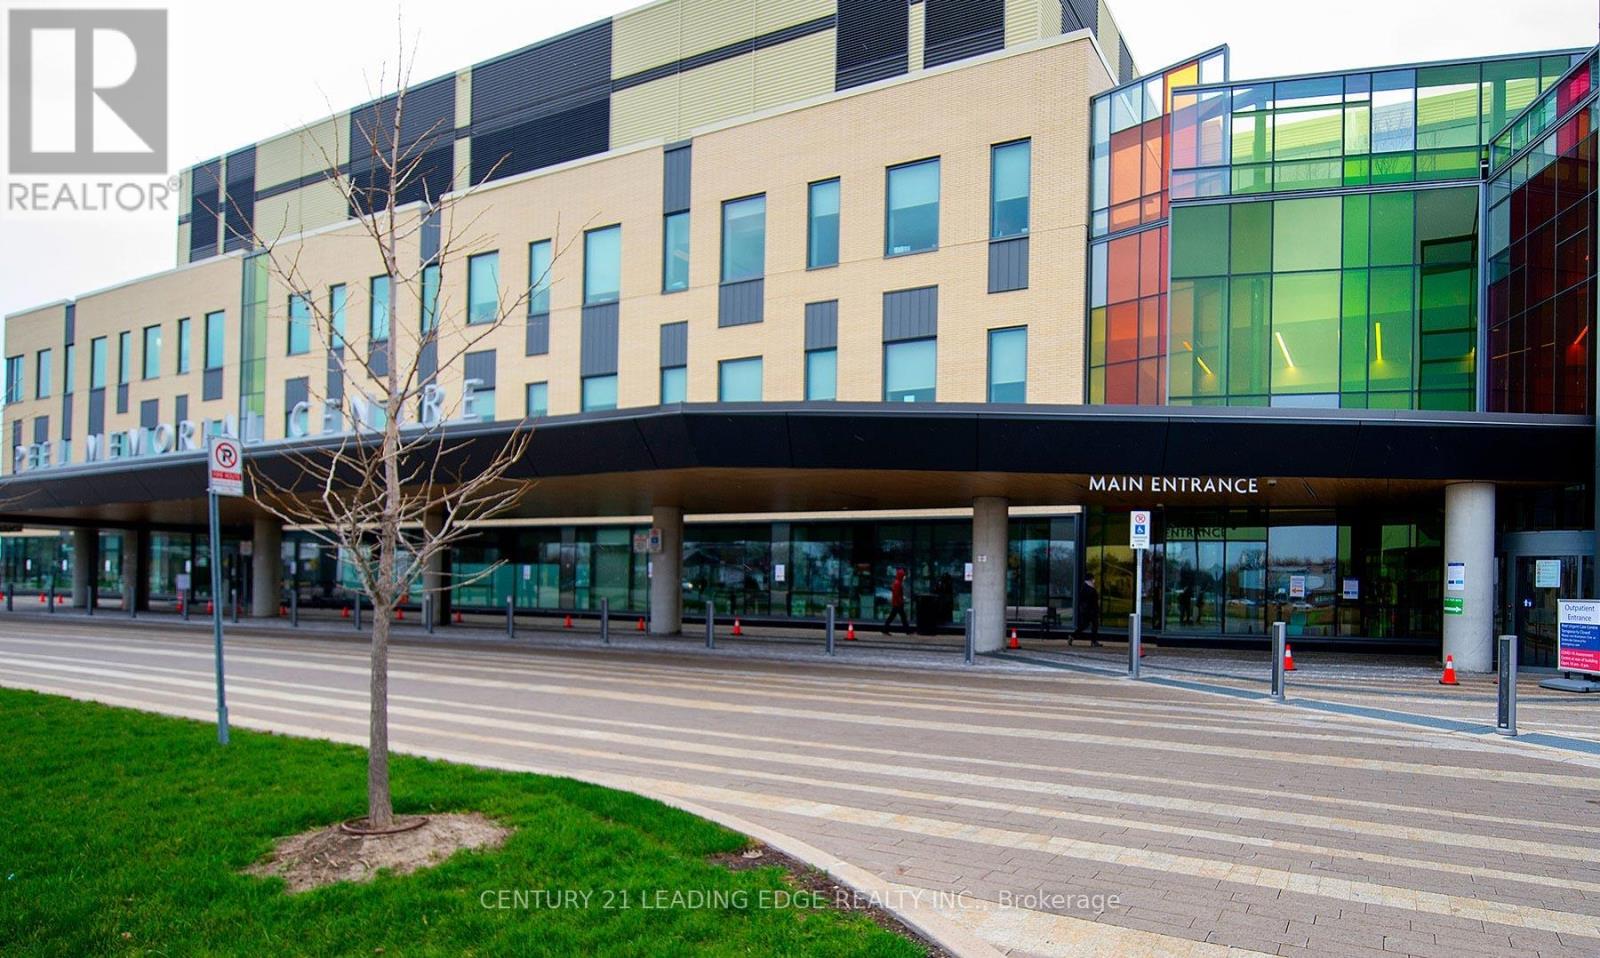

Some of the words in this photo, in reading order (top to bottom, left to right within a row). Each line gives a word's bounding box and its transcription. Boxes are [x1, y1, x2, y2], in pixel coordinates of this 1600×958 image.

[1089, 476, 1143, 492] MAIN
[1151, 477, 1258, 494] ENTRANCE
[1565, 604, 1595, 612] Outpatient
[1568, 613, 1592, 621] Entrance
